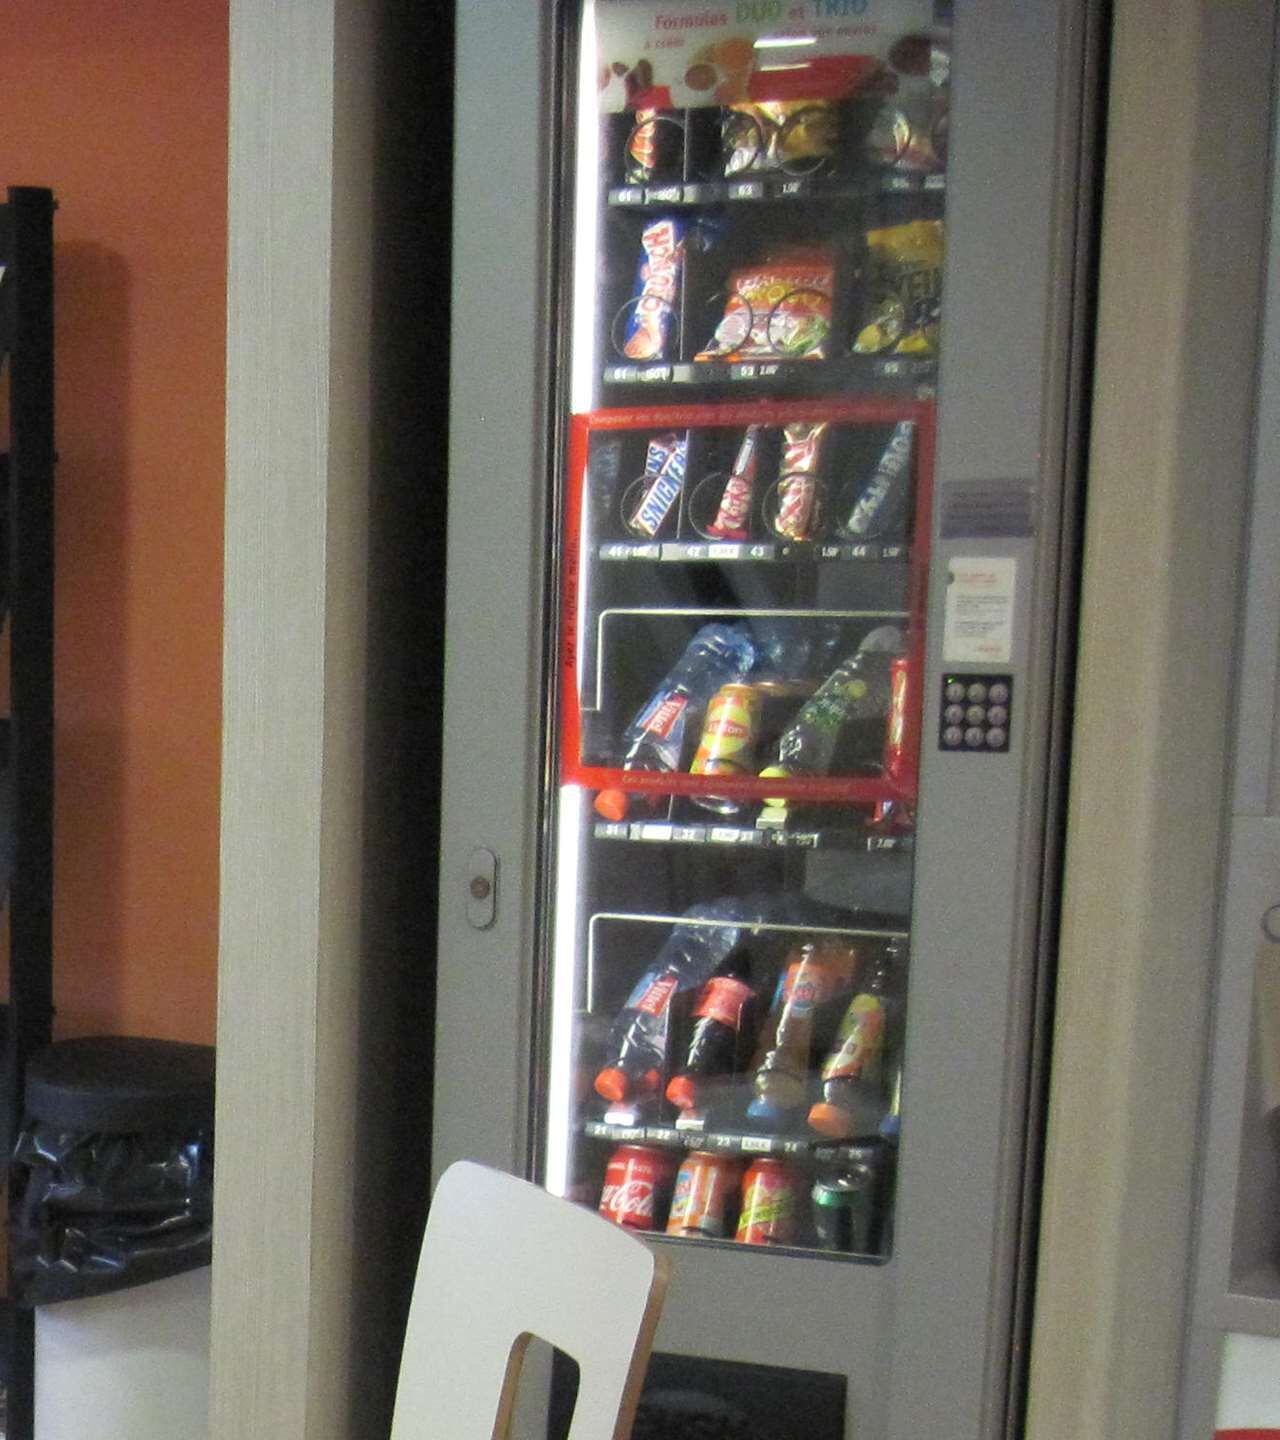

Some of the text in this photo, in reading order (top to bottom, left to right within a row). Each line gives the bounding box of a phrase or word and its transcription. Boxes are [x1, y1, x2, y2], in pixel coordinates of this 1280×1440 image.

[654, 13, 728, 30] Formules
[736, 0, 783, 24] DUO
[787, 7, 805, 20] et
